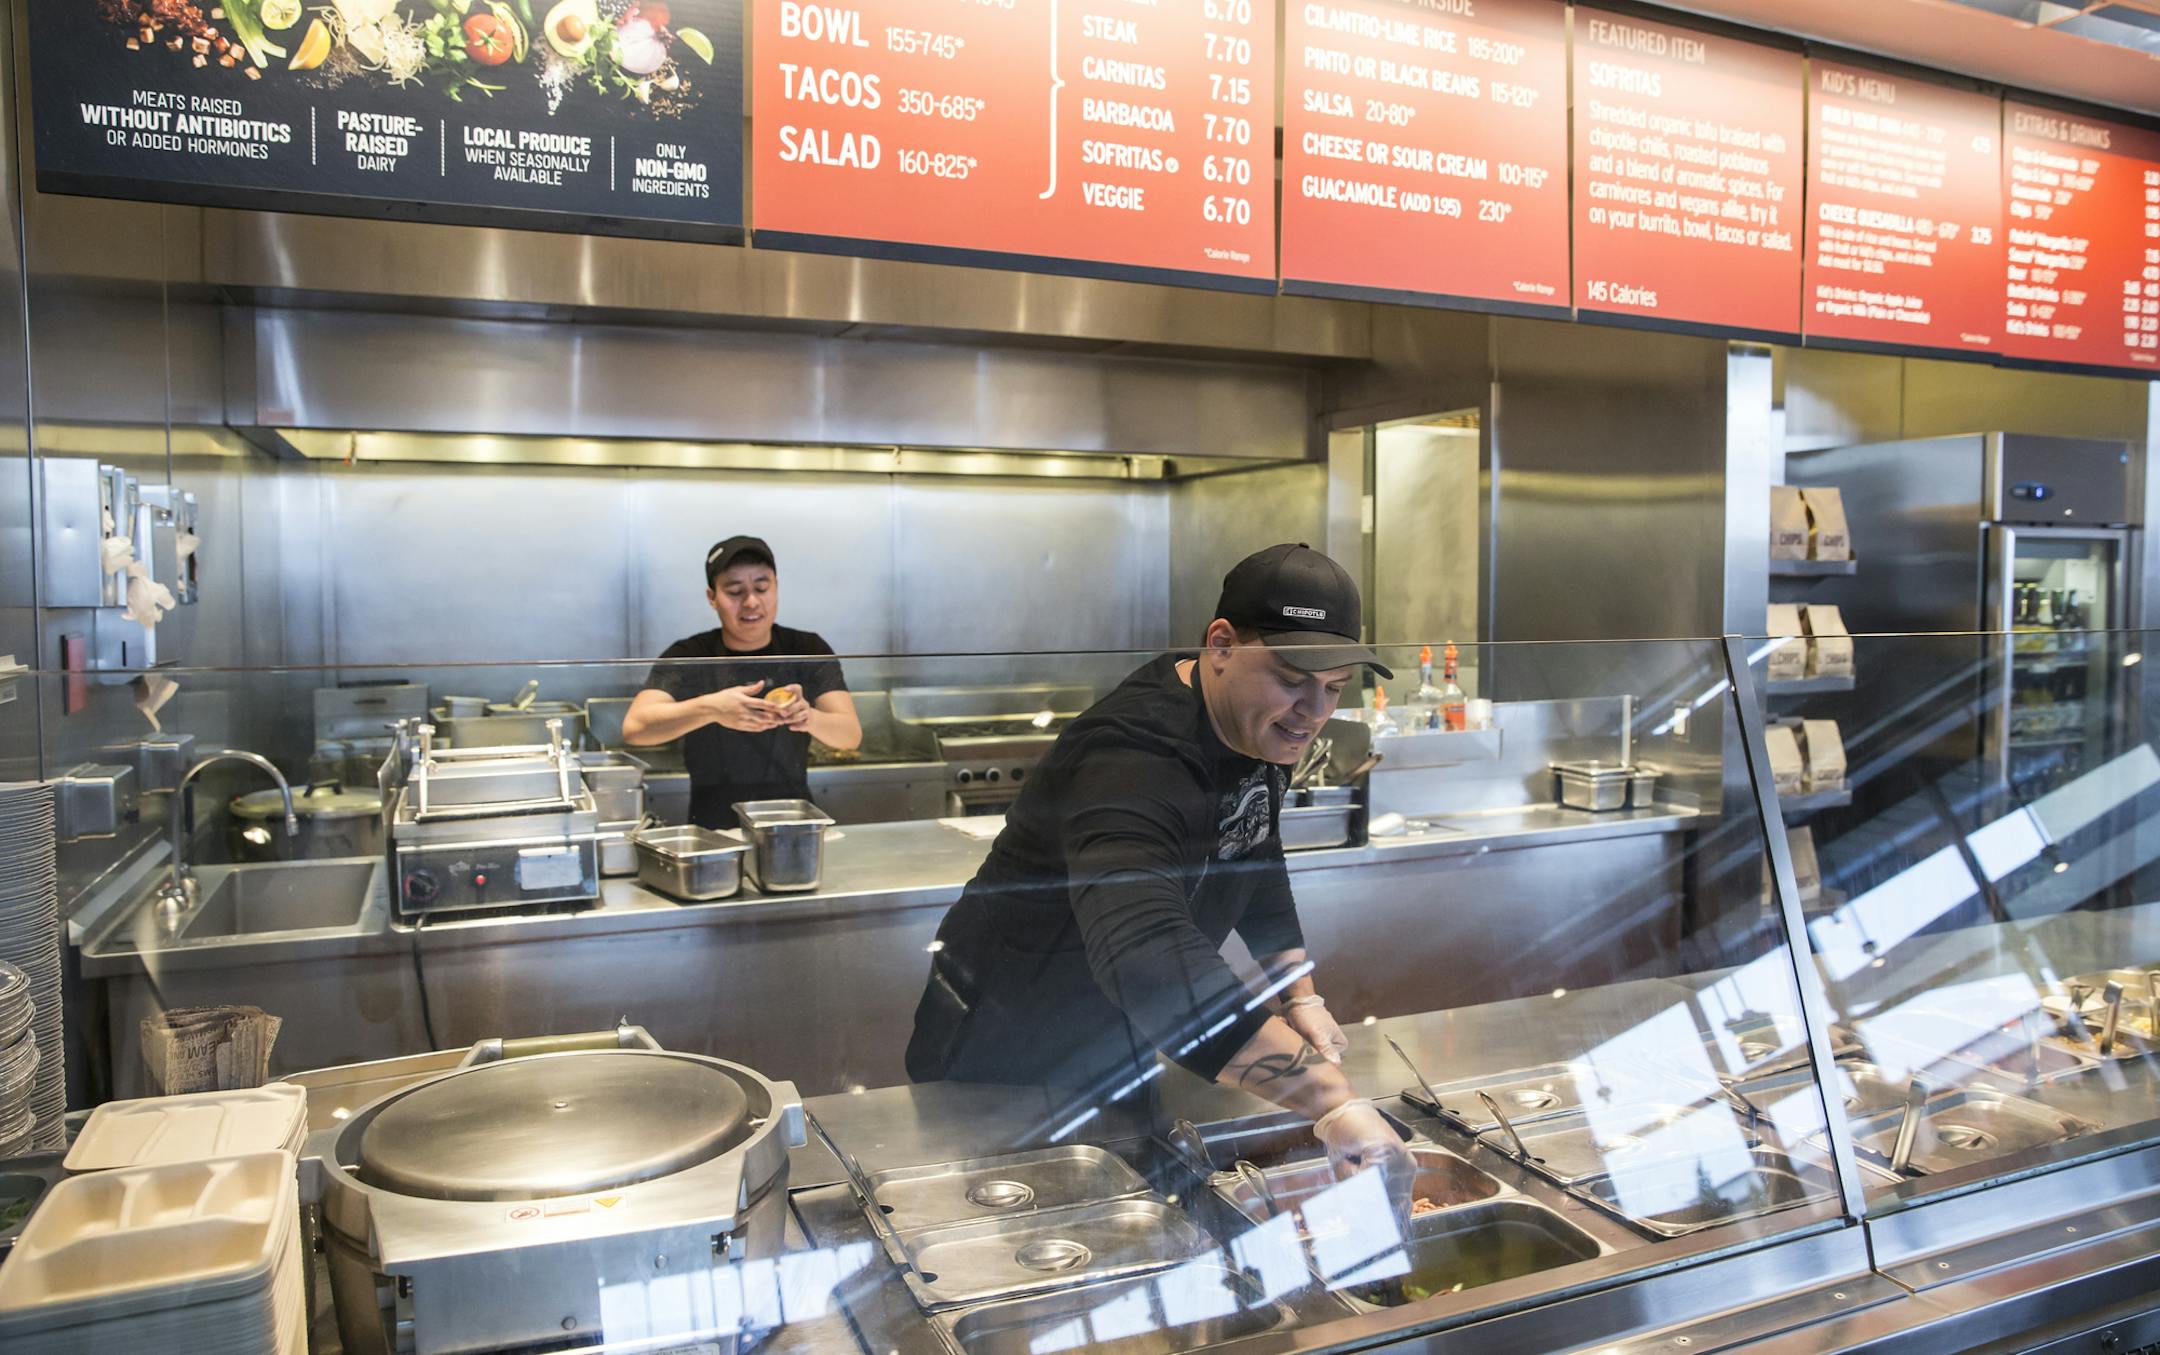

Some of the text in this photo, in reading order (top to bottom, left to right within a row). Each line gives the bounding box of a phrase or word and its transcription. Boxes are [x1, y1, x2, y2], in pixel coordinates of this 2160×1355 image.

[780, 0, 869, 47] BOWL
[1203, 0, 1251, 25] 6.70
[1304, 3, 1420, 44] CILANTRO-LIME
[1424, 26, 1456, 53] RICE
[1082, 14, 1139, 44] STEAK
[1589, 20, 1706, 64] FEATURED ITEM
[1203, 32, 1251, 65] 7.70
[779, 63, 881, 110] TACOS
[1082, 56, 1166, 90] CARNITAS
[1304, 46, 1351, 75] PINTO
[1354, 56, 1376, 79] OR
[1380, 62, 1428, 90] BLACK
[1432, 70, 1480, 99] BEANS
[1588, 62, 1662, 97] SOFRITAS
[1821, 70, 1896, 104] KID'S MENU
[133, 90, 242, 116] MEATS RAISED
[1209, 74, 1251, 105] 7.15
[1303, 89, 1354, 117] SALSA
[81, 103, 291, 144] WITHOUT ANTIBIOTICS
[337, 110, 423, 137] PASTURE-
[1082, 98, 1175, 133] BARBACOA
[1203, 114, 1251, 145] 7.70
[1588, 100, 1647, 130] Shredded
[1649, 113, 1691, 137] organic
[1720, 124, 1760, 149] braised
[1762, 133, 1786, 153] with
[2014, 111, 2059, 139] EXTRAS
[2070, 124, 2111, 150] DRINKS
[107, 129, 269, 160] OR ADDED HORMONES
[346, 132, 408, 156] RAISED
[463, 125, 591, 156] LOCAL PRODUCE
[656, 143, 687, 160] ONLY
[779, 125, 881, 169] SALAD
[1302, 132, 1363, 161] CHEESE
[1366, 142, 1389, 165] OR
[1391, 145, 1433, 172] SOUR
[1437, 152, 1487, 180] CREAM
[1588, 128, 1637, 156] chipotle
[1674, 141, 1717, 165] roasted
[1719, 149, 1769, 175] poblanos
[357, 155, 396, 172] DAIRY
[465, 148, 590, 173] WHEN SEASONALLY
[635, 158, 707, 182] NON-GMO
[1082, 141, 1163, 172] SOFRITAS
[1203, 154, 1250, 185] 6.70
[493, 166, 562, 186] AVAILABLE
[632, 178, 710, 198] INGREDIENTS
[1588, 154, 1613, 173] and
[1615, 161, 1624, 174] a
[1626, 158, 1659, 182] blend
[1661, 164, 1674, 183] of
[1676, 169, 1726, 193] aromatic
[1766, 181, 1786, 202] For
[1082, 182, 1145, 212] VEGGIE
[1203, 195, 1250, 225] 6.70
[1302, 175, 1397, 209] GUACAMOLE
[1400, 191, 1431, 214] (ADD
[1588, 180, 1652, 206] carnivores
[1654, 189, 1677, 209] and
[1679, 197, 1719, 219] vegans
[1750, 206, 1768, 225] try
[1588, 208, 1606, 225] on
[1608, 212, 1637, 230] your
[1638, 213, 1681, 237] burrito,
[1683, 218, 1712, 242] bowl,
[1714, 224, 1745, 246] tacos
[1746, 230, 1760, 247] or
[1587, 280, 1657, 308] 145 Calories
